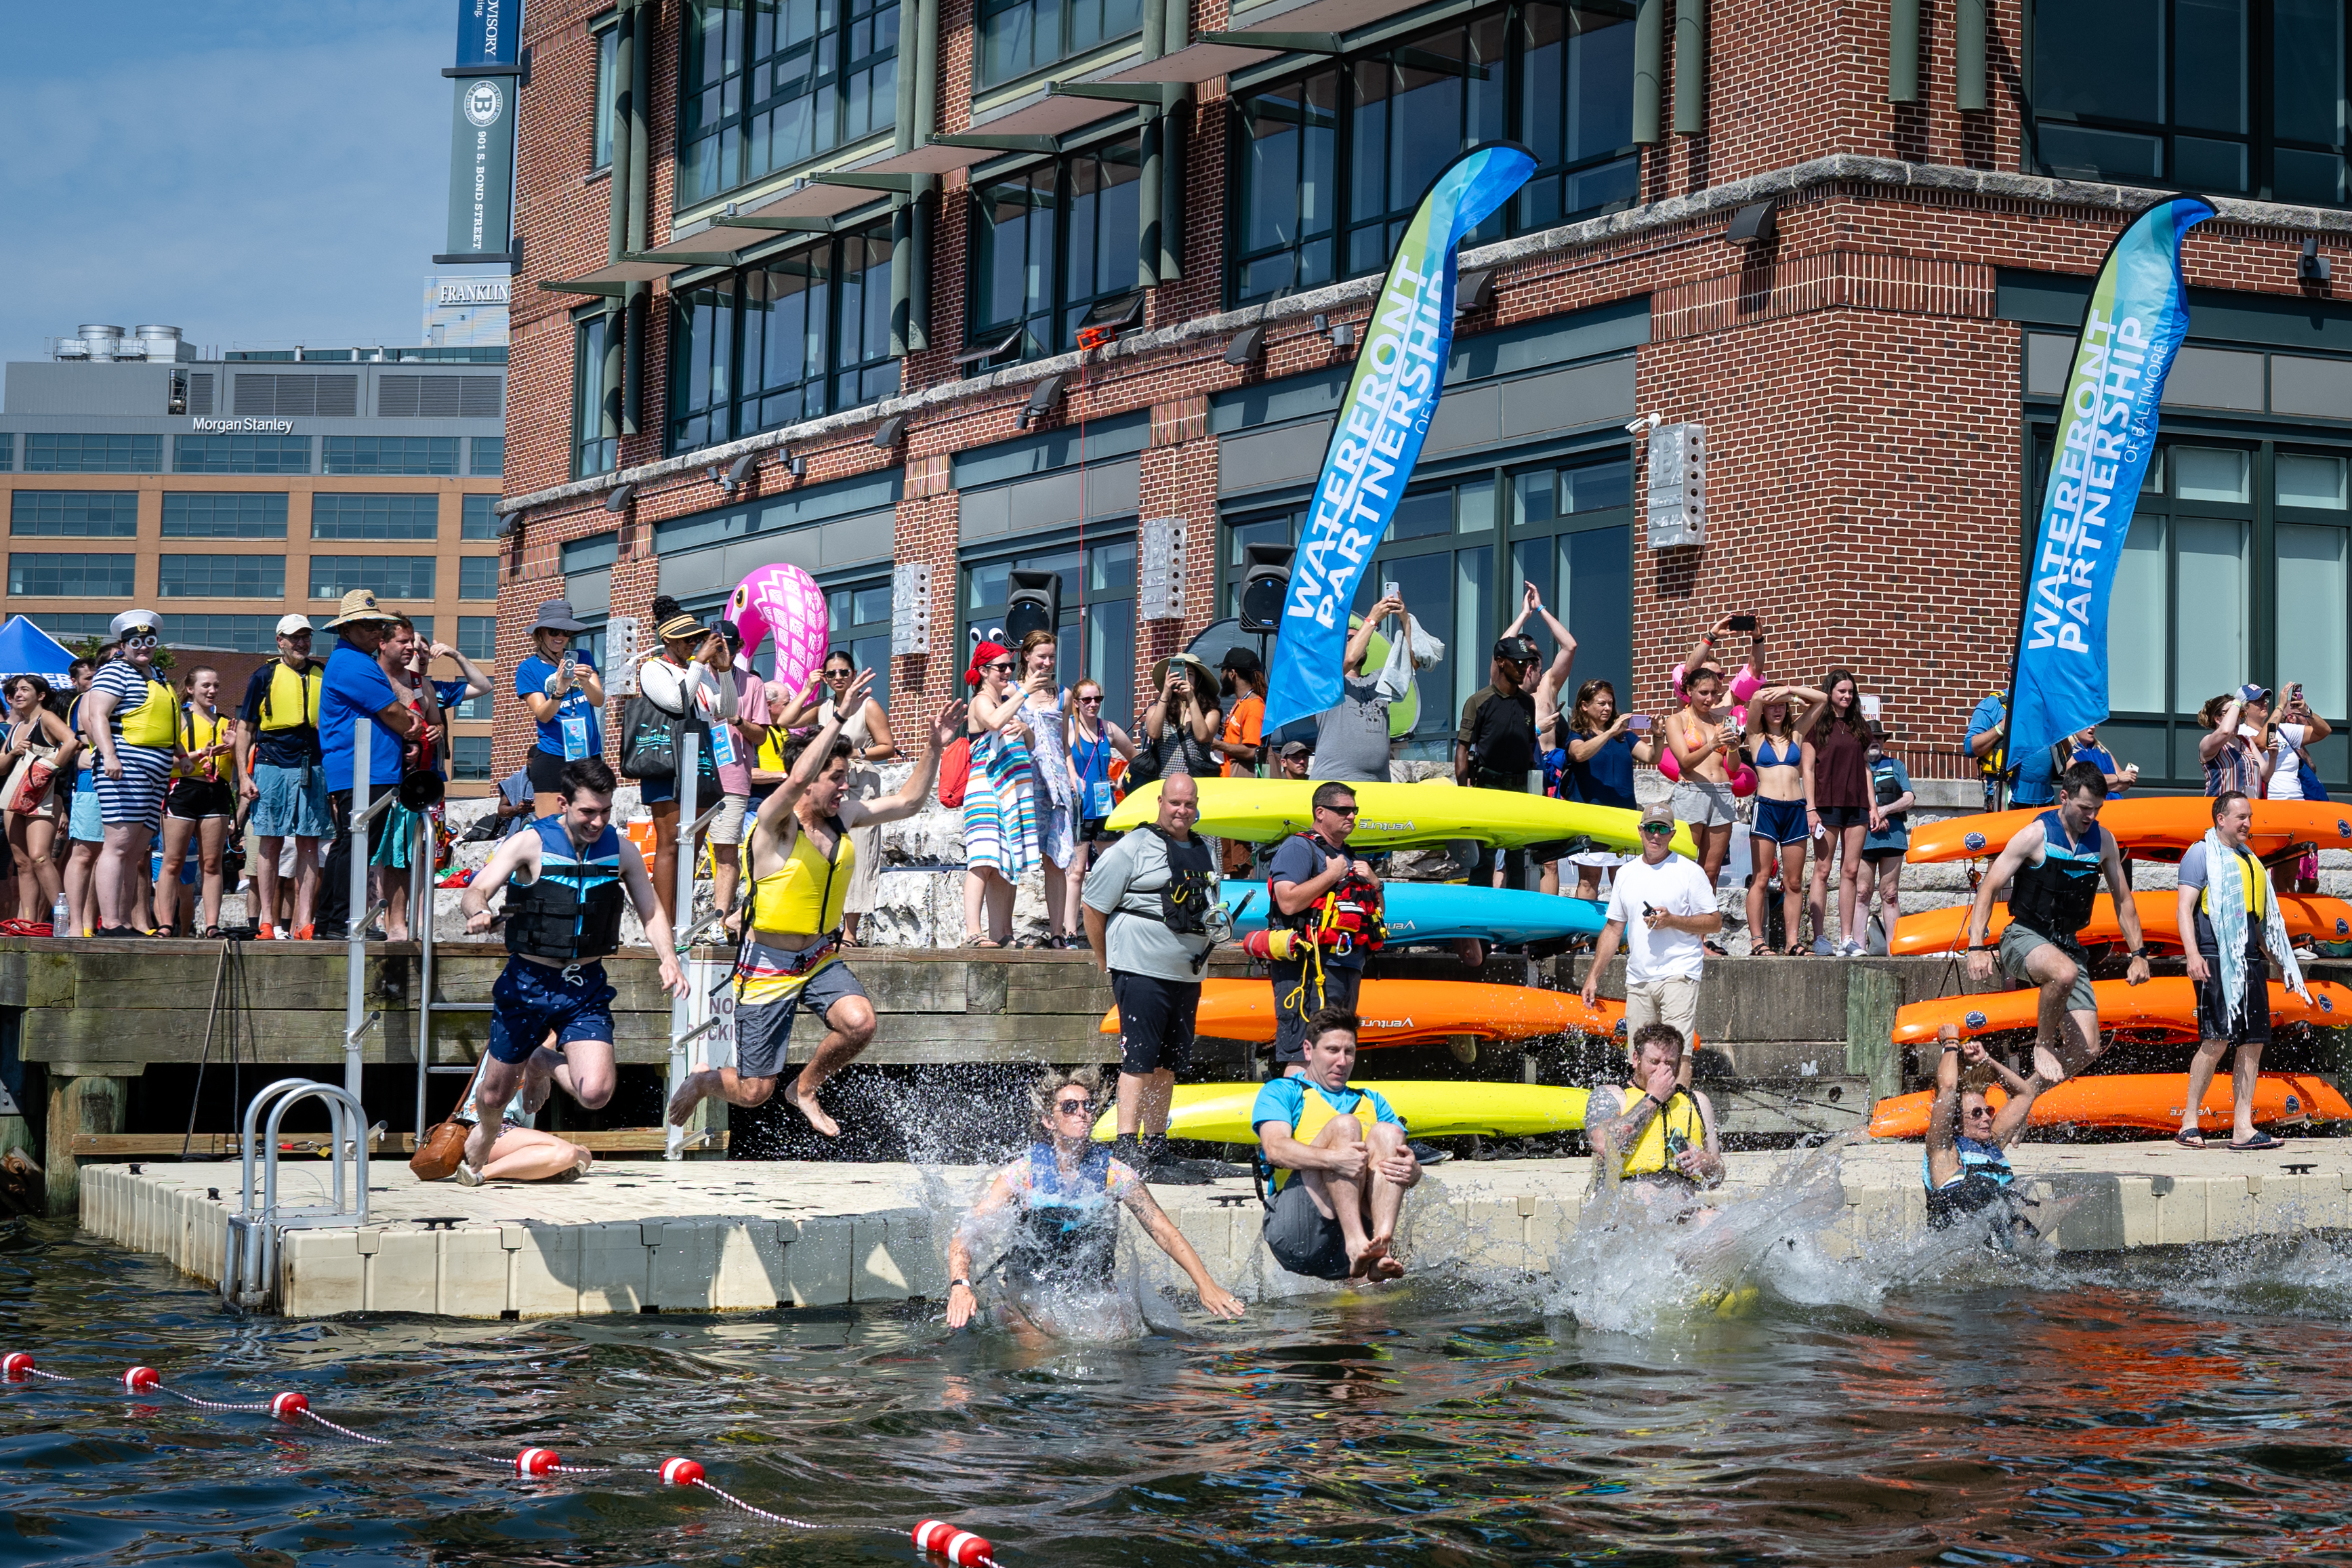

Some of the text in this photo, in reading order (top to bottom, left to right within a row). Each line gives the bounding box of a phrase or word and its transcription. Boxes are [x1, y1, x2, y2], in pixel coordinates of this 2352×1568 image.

[474, 95, 493, 112] B
[472, 131, 487, 249] 901 S. BOND STREET
[440, 285, 510, 302] FRANKLIN
[193, 417, 293, 434] Morgan Stanley
[1287, 255, 1427, 619] WATERFRONT
[1315, 270, 1443, 630] PARTNERSHIP
[2124, 342, 2169, 463] OF BALTIMORE
[2027, 308, 2117, 650] WATERFRONT
[2056, 316, 2149, 654] PARTNERSHIP
[1359, 820, 1416, 831] Venture
[709, 997, 733, 1014] NO
